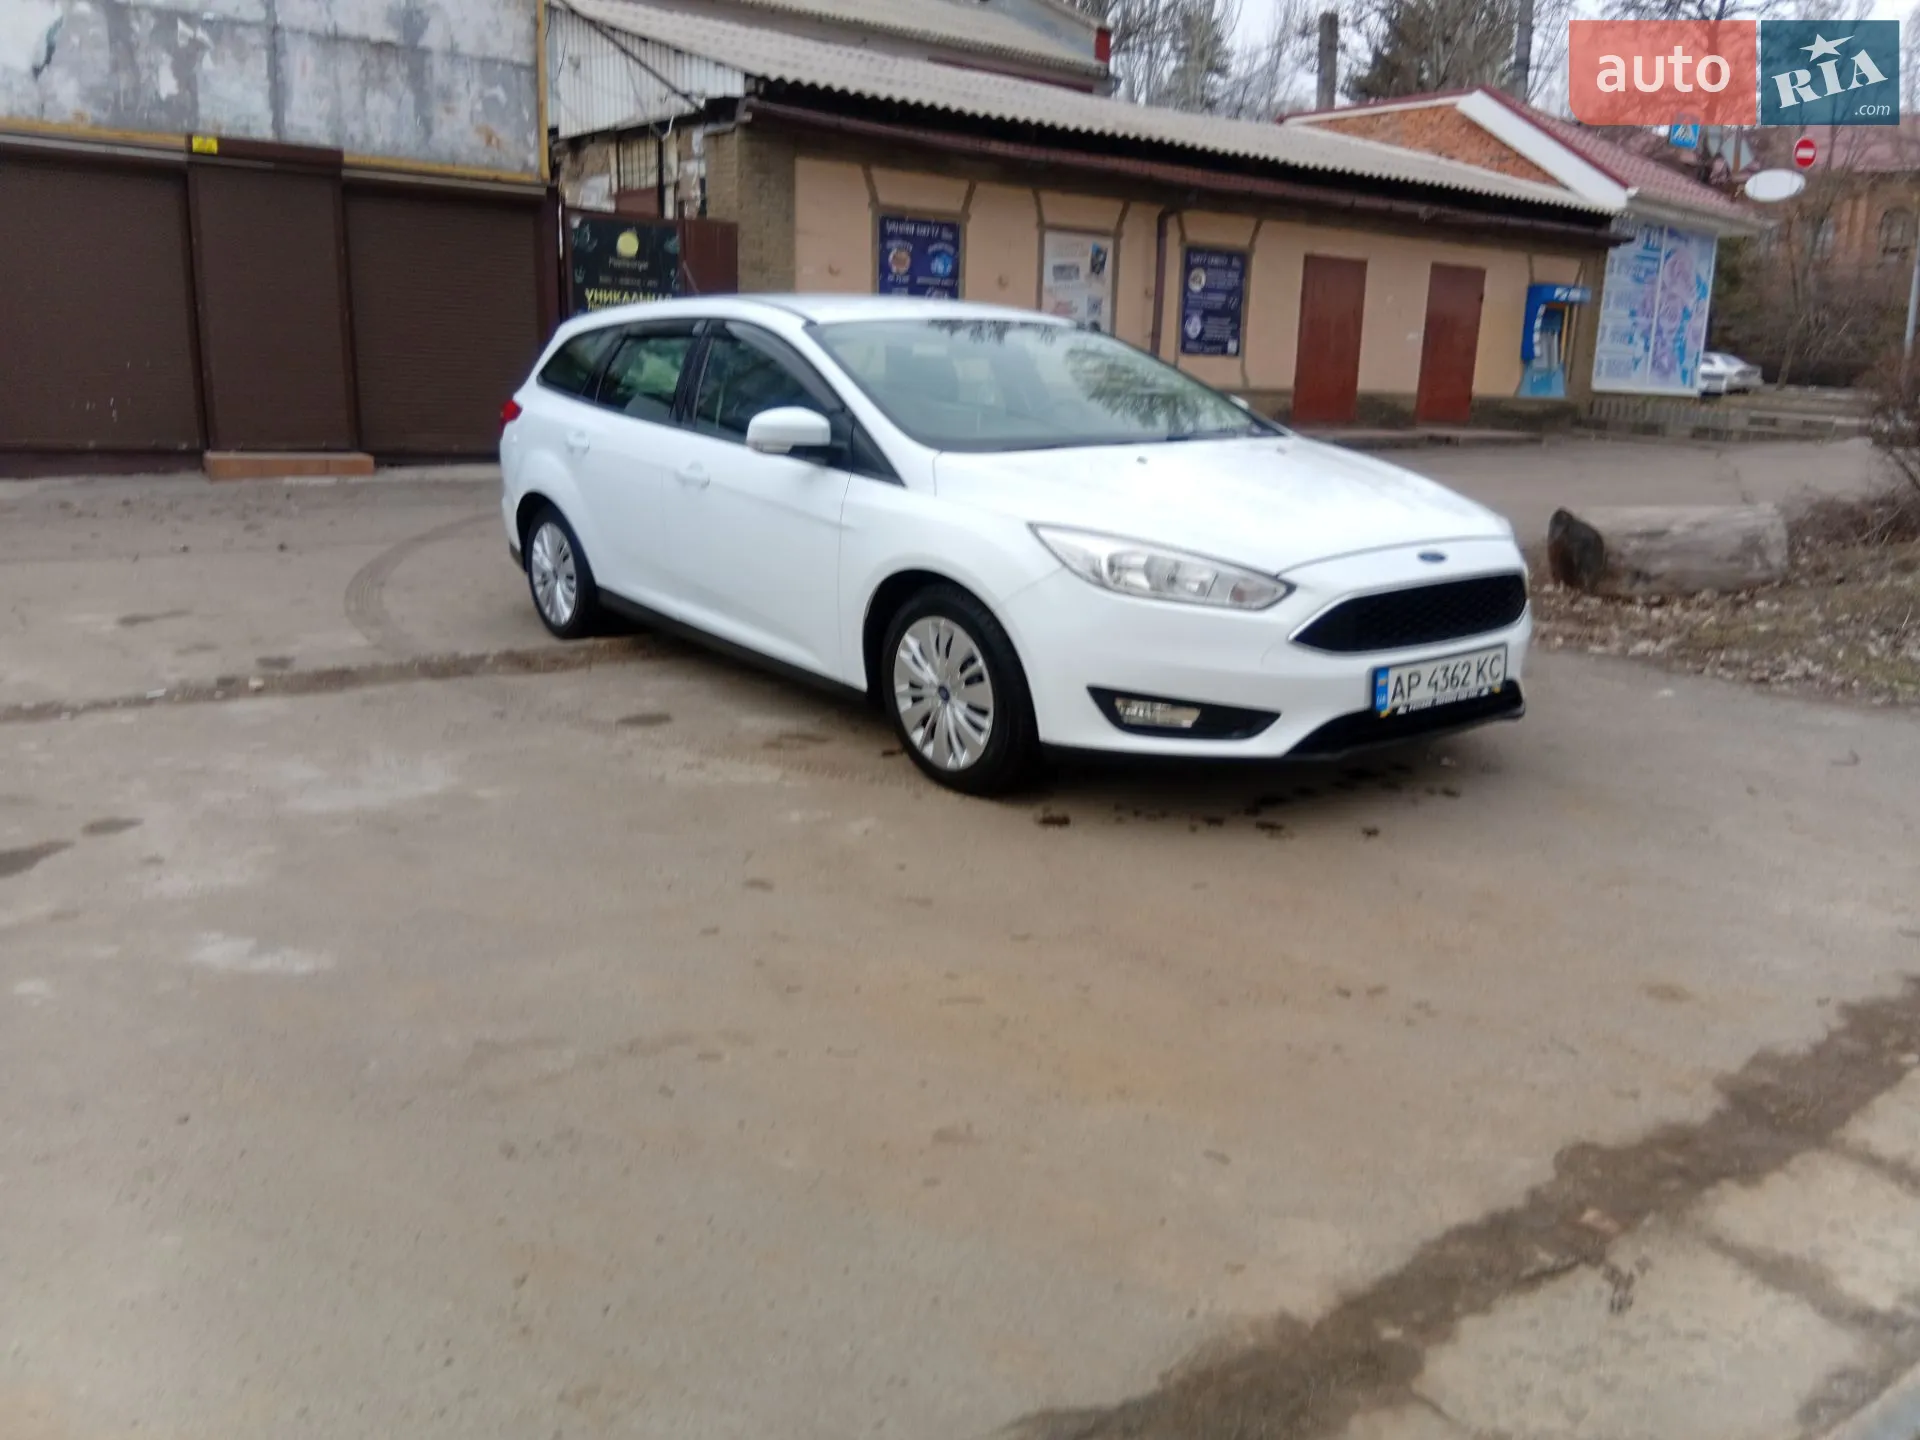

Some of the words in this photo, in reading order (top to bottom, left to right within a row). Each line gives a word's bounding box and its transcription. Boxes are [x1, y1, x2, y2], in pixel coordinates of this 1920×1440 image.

[1391, 669, 1422, 703] AP
[1427, 660, 1471, 694] 4362
[1475, 653, 1501, 685] KC
